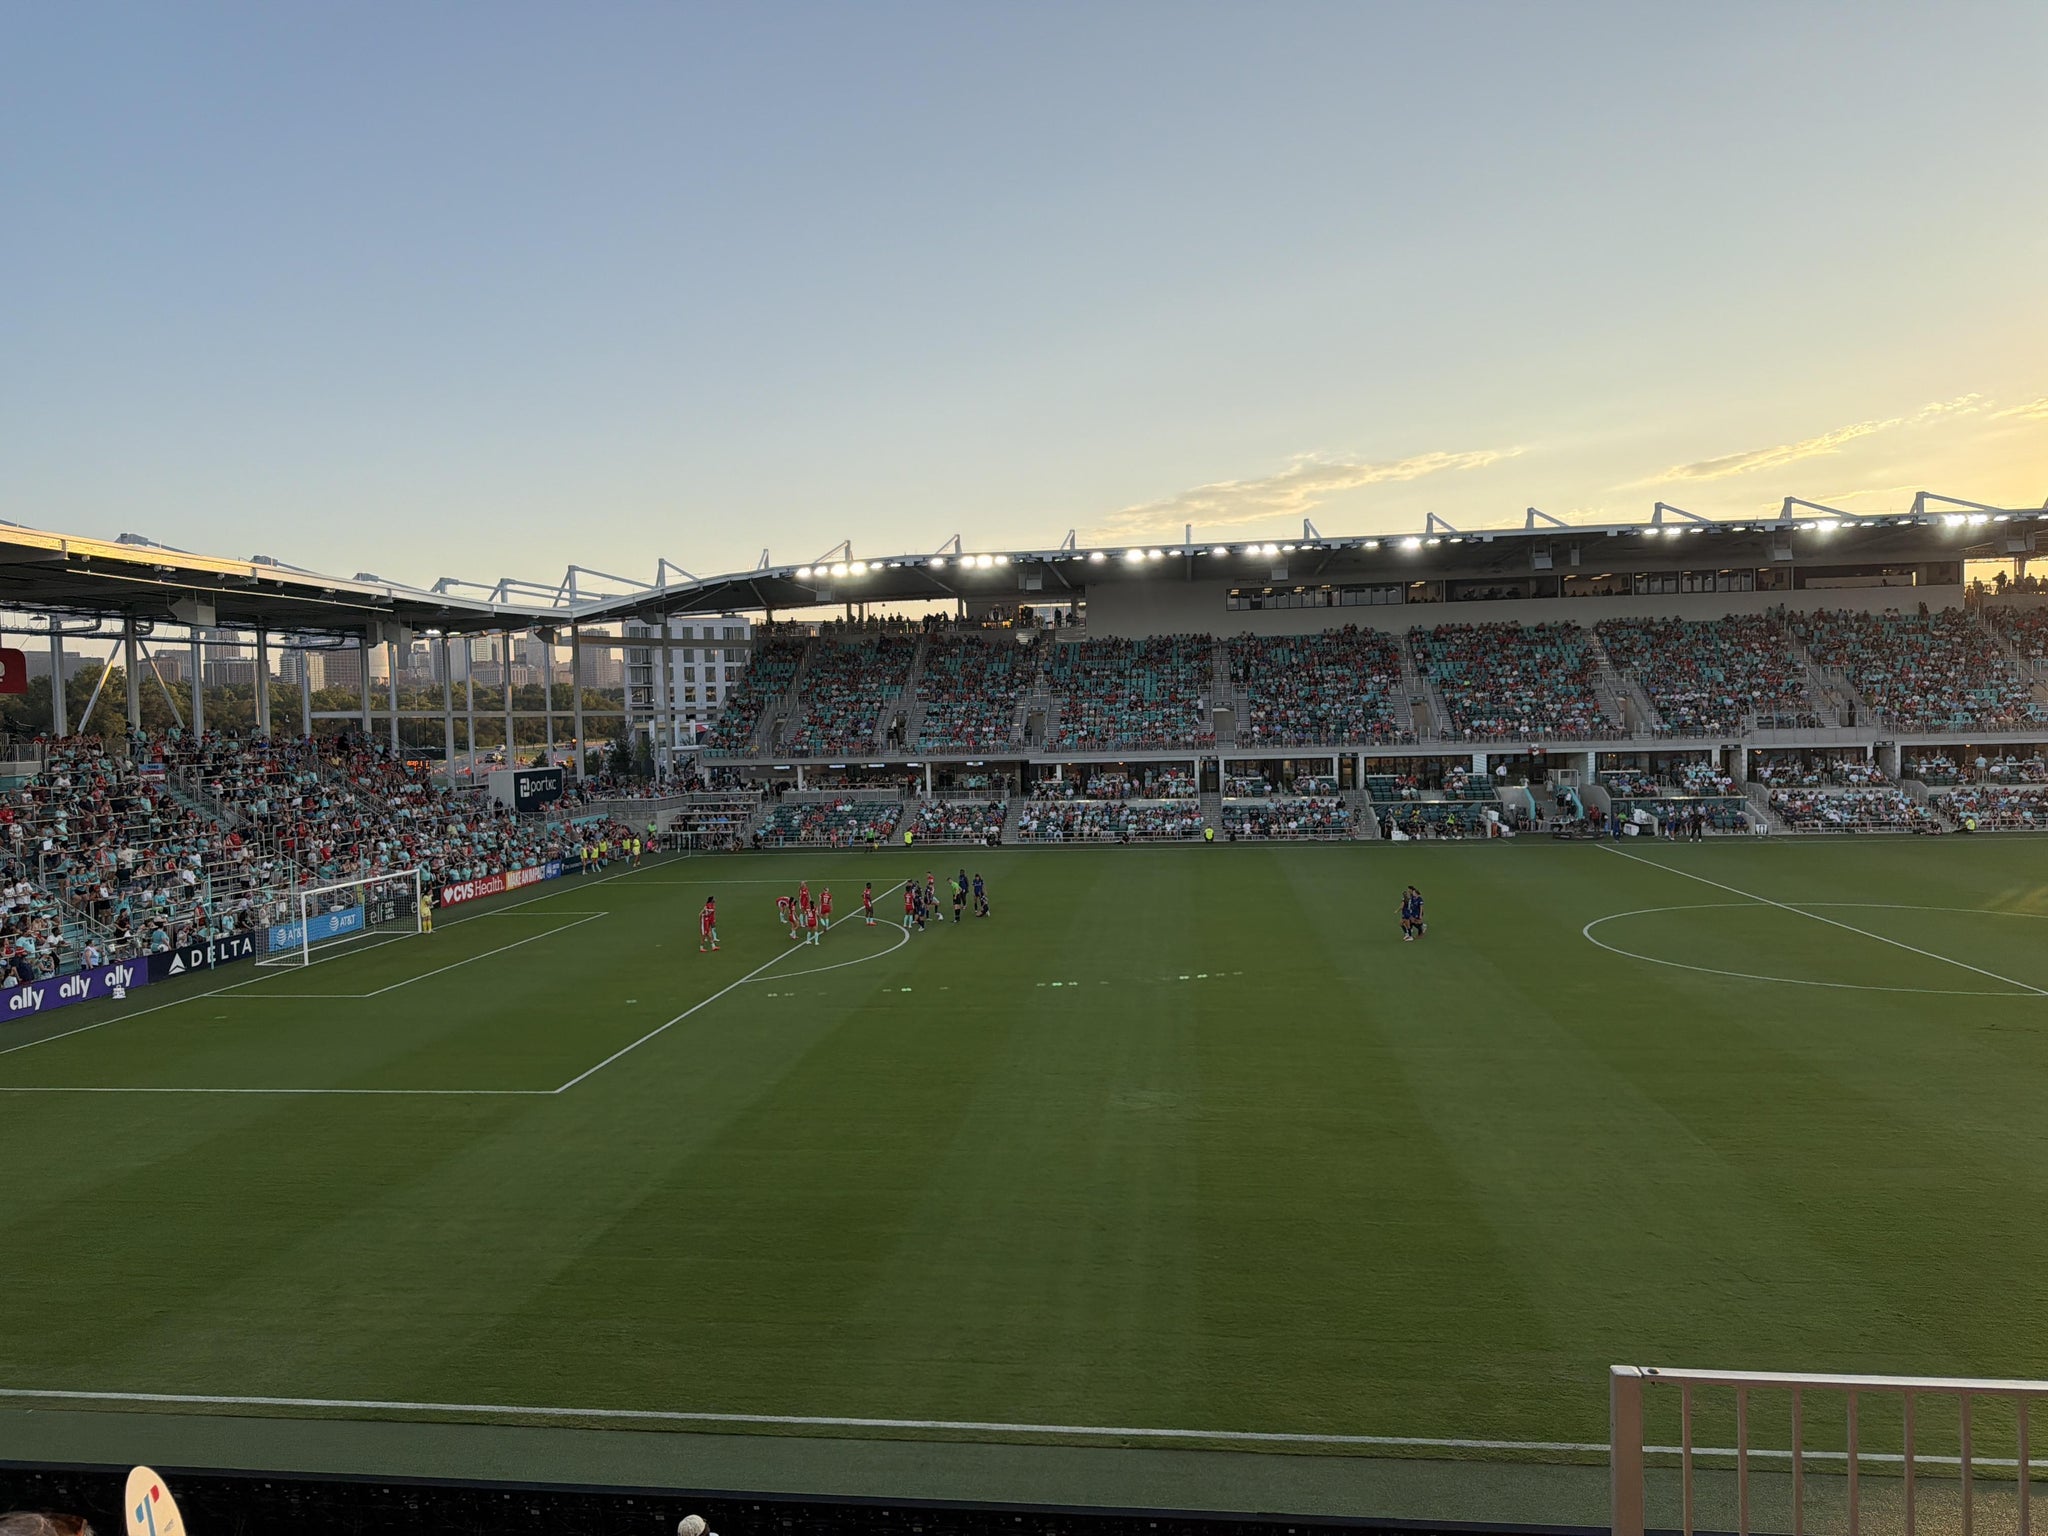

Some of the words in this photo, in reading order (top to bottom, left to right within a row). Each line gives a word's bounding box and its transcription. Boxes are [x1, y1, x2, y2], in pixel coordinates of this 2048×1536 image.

[453, 882, 474, 902] CVS
[340, 914, 356, 927] AT&T
[370, 902, 385, 923] elf
[191, 938, 253, 967] DELTA
[60, 975, 91, 998] ally
[104, 965, 134, 987] ally
[9, 986, 44, 1011] ally
